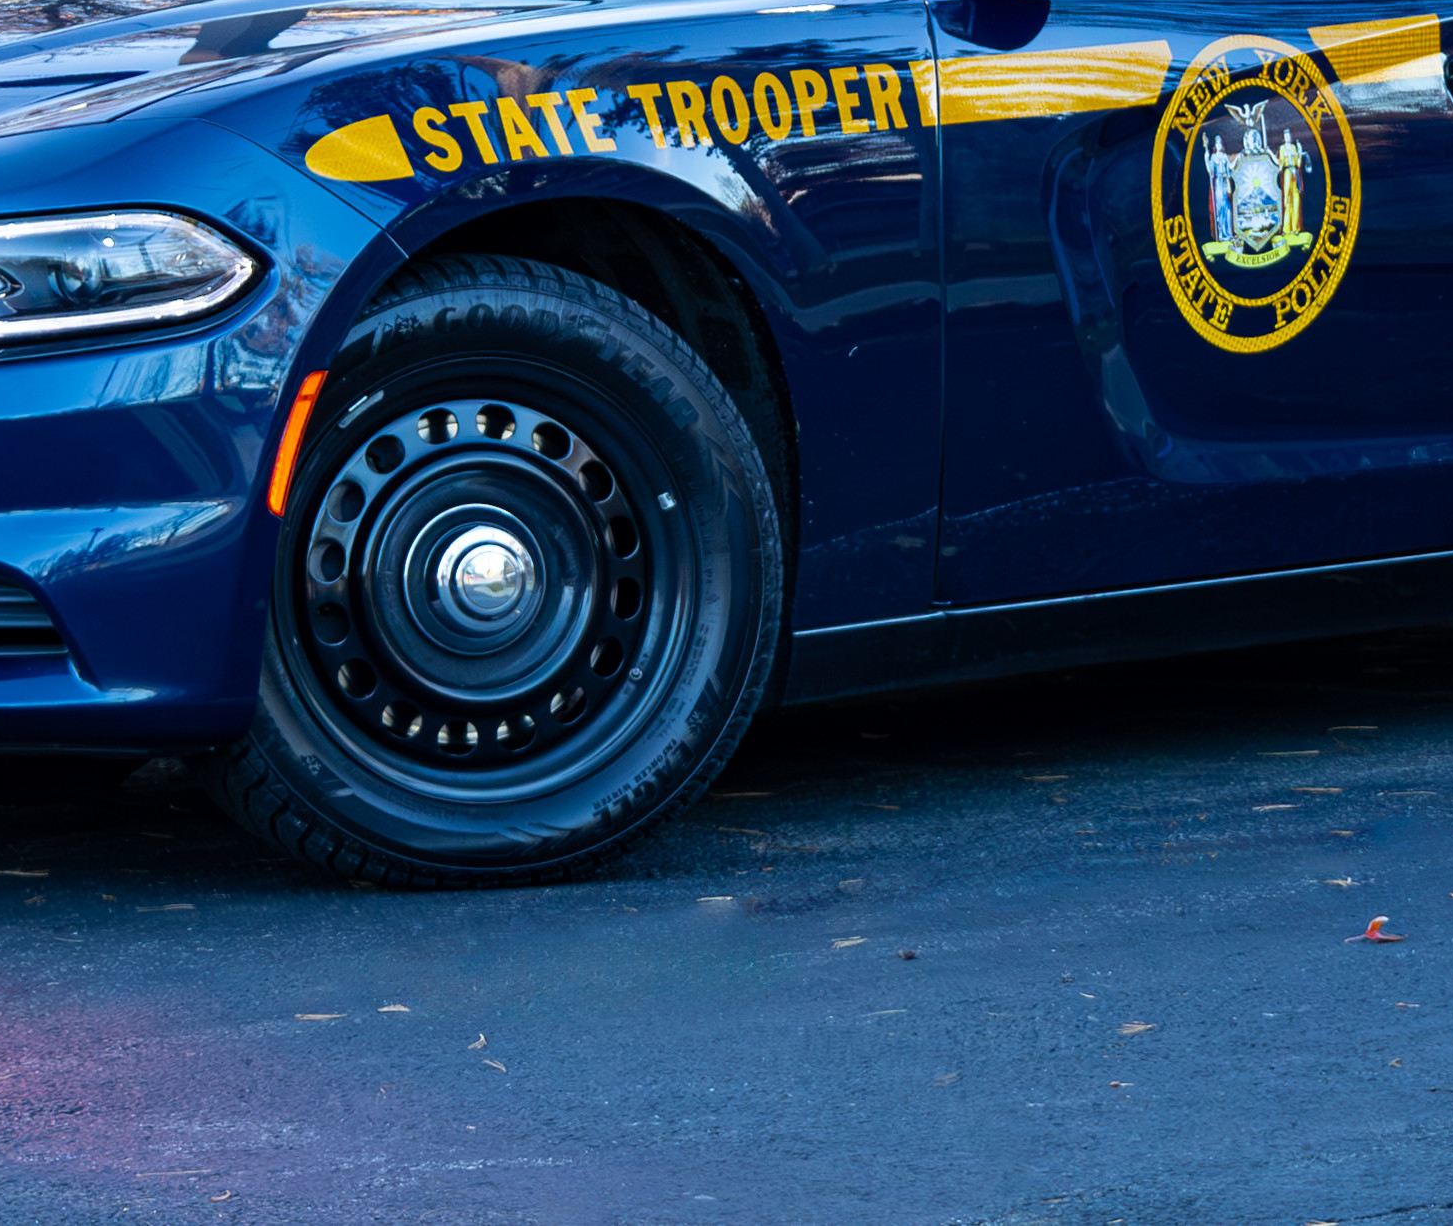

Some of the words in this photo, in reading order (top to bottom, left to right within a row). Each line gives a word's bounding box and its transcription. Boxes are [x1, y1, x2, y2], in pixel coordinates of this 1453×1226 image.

[411, 86, 617, 173] STATE
[627, 63, 909, 149] TROOPER
[1171, 55, 1232, 142] NEW
[1254, 49, 1333, 131] YORK
[1163, 214, 1234, 331] STATE
[1272, 195, 1351, 329] POLICE
[1235, 251, 1281, 265] EXCELSIOR
